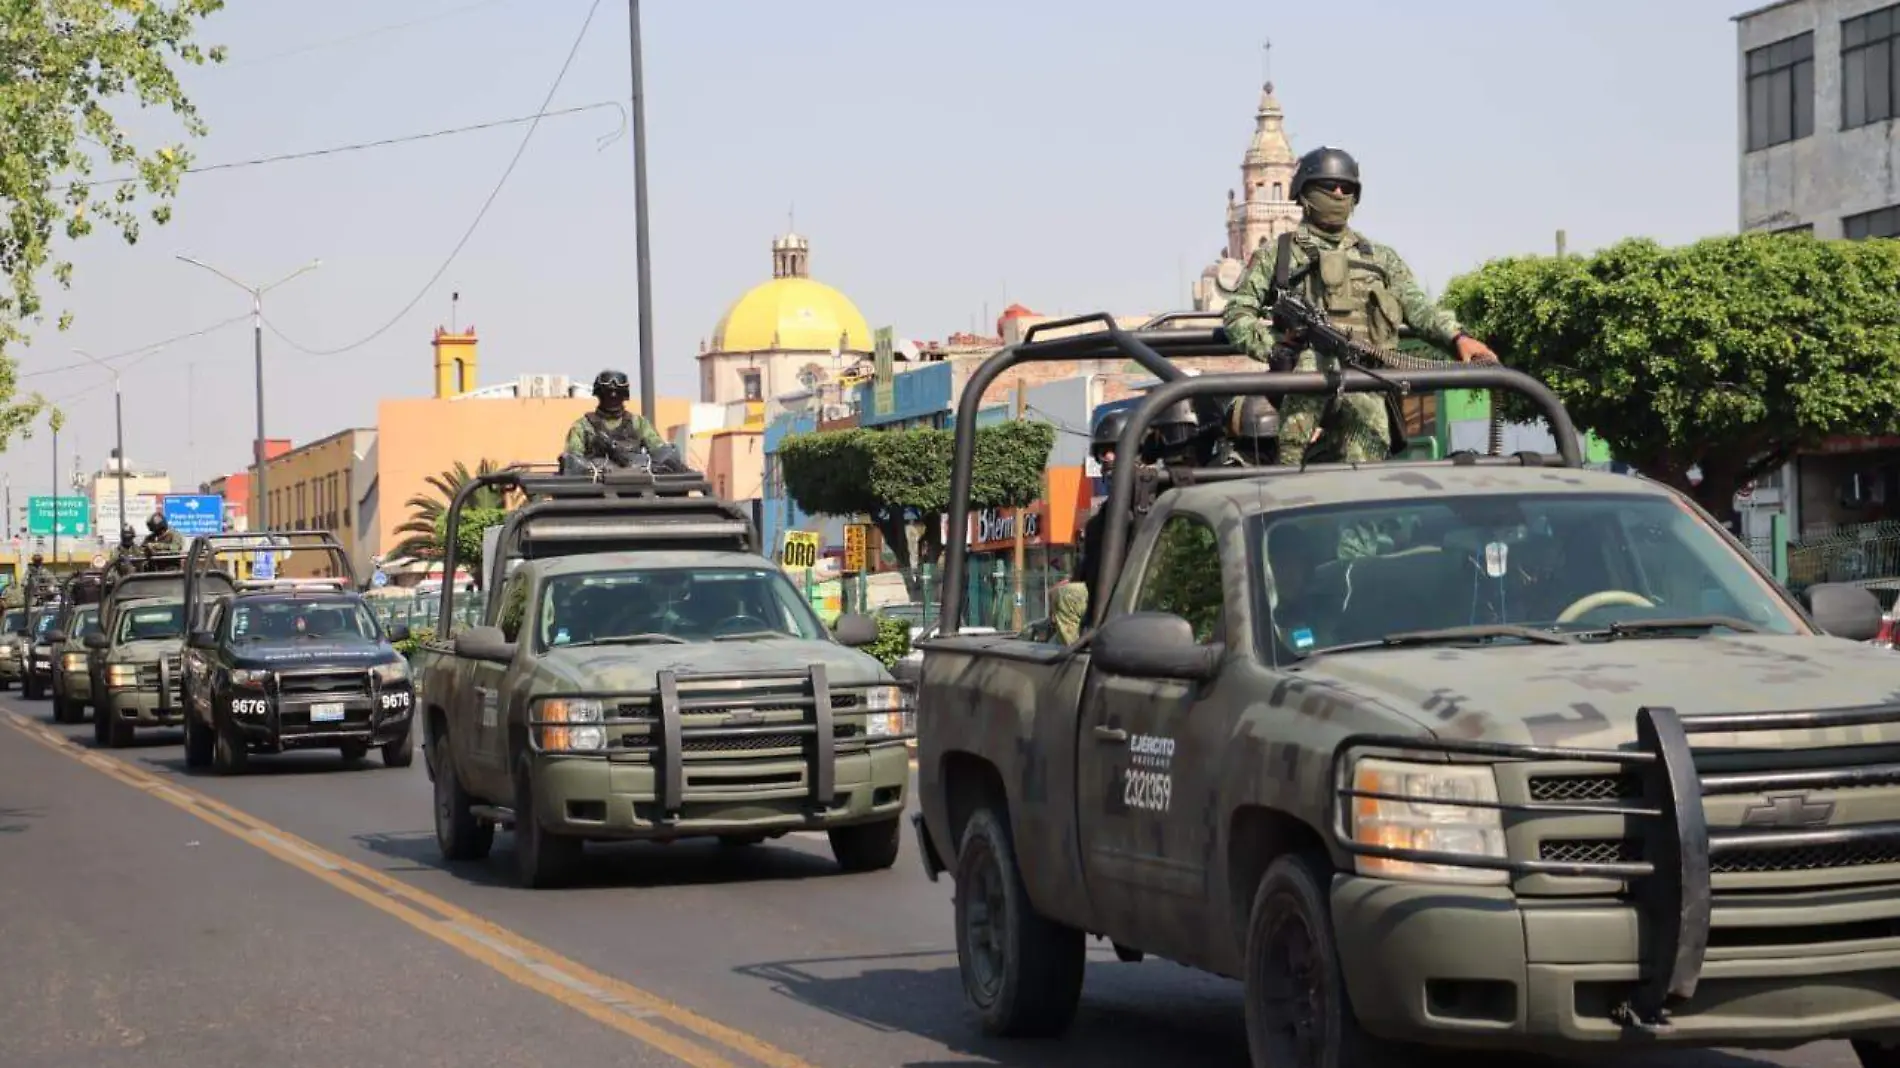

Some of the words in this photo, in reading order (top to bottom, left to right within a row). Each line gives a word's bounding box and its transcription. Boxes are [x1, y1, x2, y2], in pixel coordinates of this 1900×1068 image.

[785, 541, 816, 567] ORO
[231, 699, 266, 714] 9676
[382, 692, 409, 709] 9676
[1124, 769, 1172, 812] 2321359
